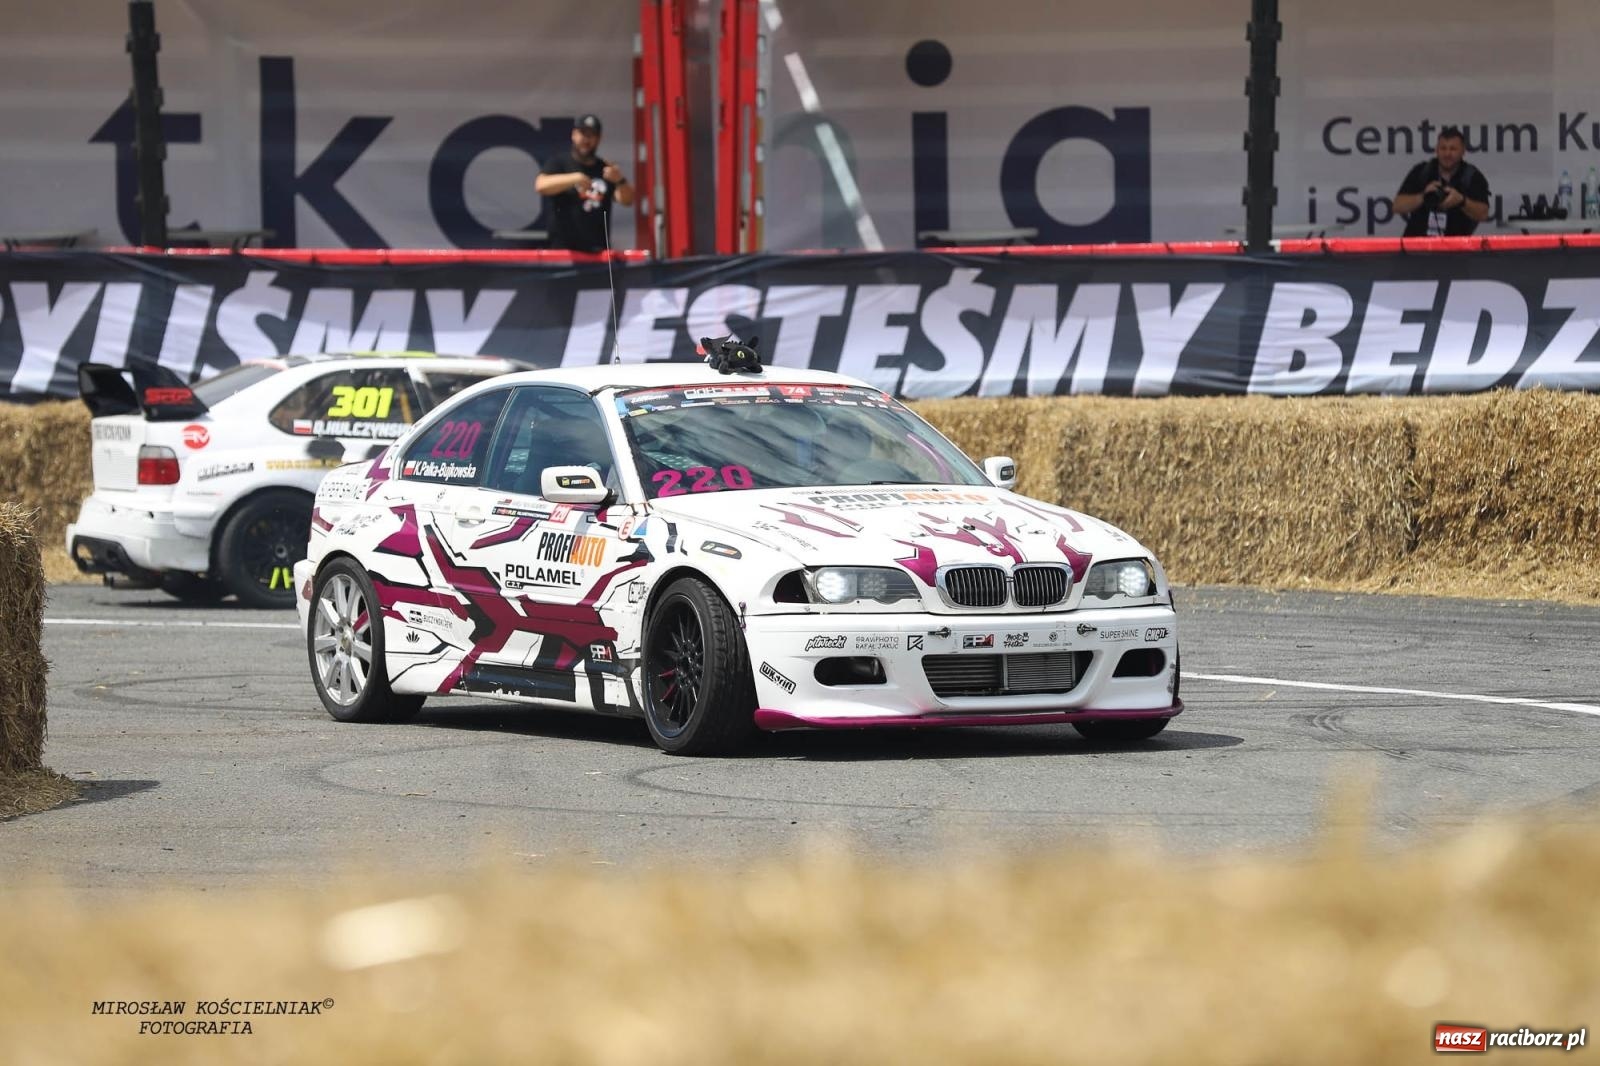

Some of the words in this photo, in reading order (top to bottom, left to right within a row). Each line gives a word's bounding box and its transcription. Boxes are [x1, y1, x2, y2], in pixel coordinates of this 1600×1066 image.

[1321, 116, 1538, 156] Centum
[1307, 186, 1318, 224] i
[327, 385, 394, 418] 301
[431, 420, 482, 459] 220
[651, 465, 755, 498] 220
[809, 492, 988, 505] PROFIAUTO
[621, 522, 632, 535] E
[536, 531, 606, 567] PROFIAUTO
[505, 563, 582, 586] POLAMEL
